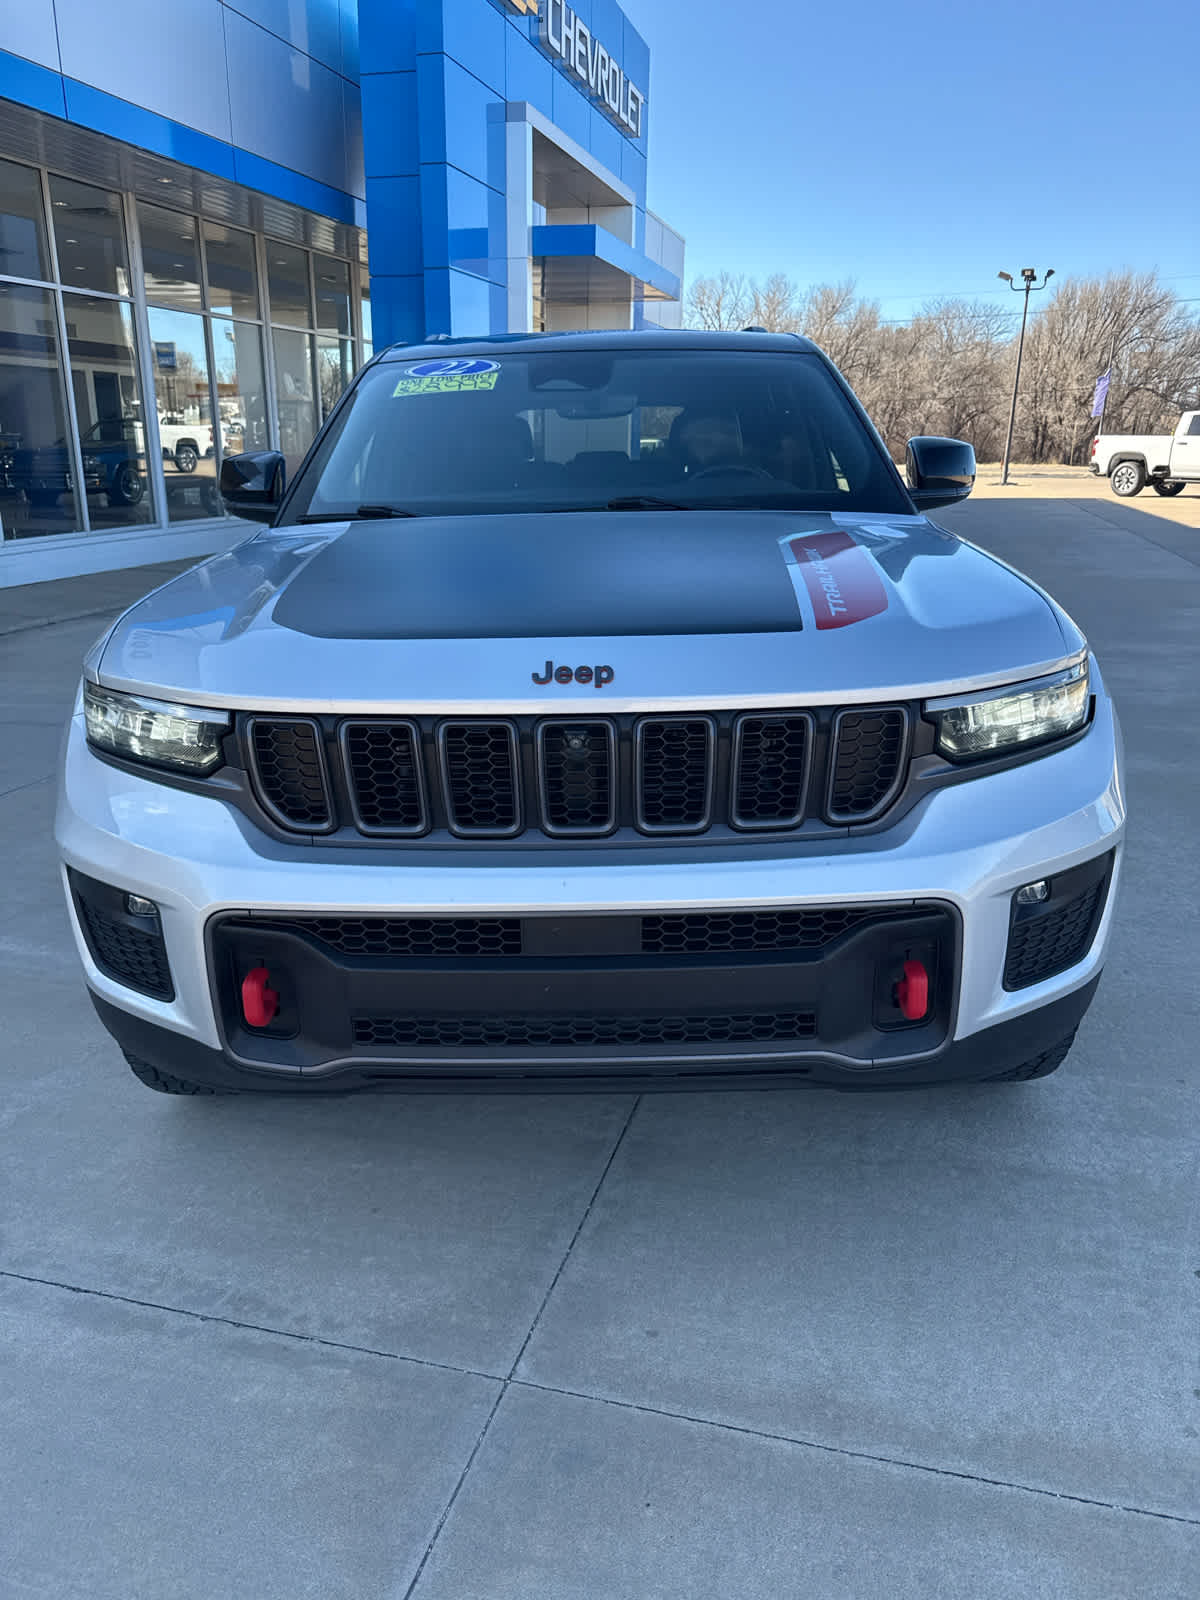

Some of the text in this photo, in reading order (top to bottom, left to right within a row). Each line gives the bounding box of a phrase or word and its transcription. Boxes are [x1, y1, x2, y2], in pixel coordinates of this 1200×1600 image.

[547, 0, 645, 137] CHEVROLET
[427, 361, 477, 376] 22
[531, 660, 615, 688] Jeep
